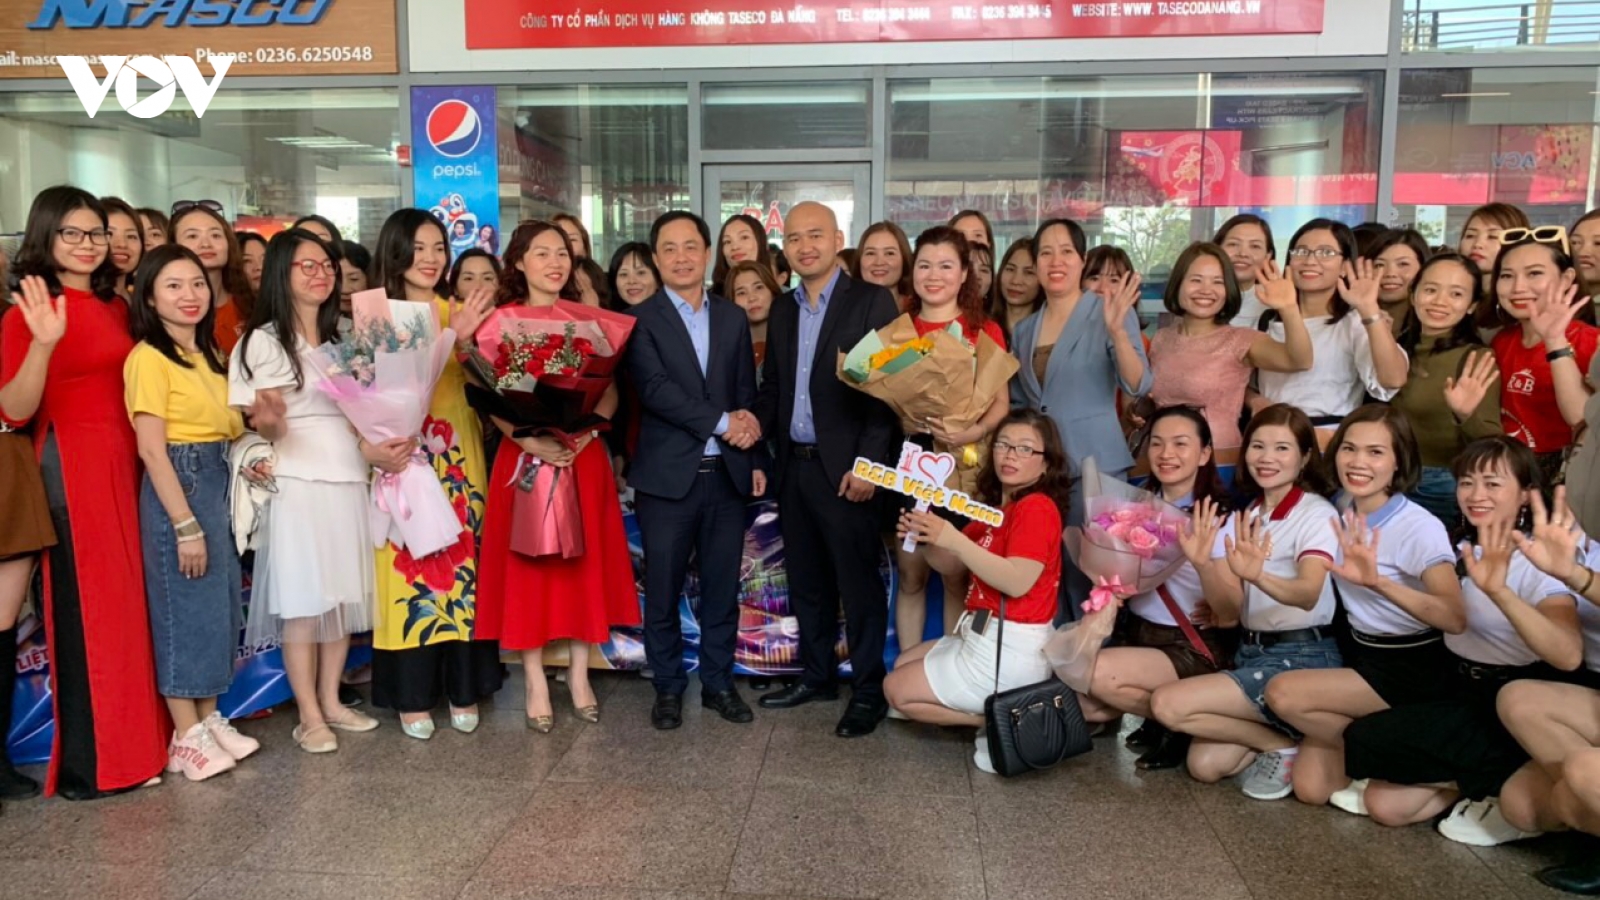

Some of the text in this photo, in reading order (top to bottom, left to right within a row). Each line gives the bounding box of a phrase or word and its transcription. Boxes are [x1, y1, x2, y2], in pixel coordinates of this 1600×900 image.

[520, 12, 547, 28] CÔNG
[551, 14, 564, 28] TY
[566, 8, 581, 28] CỔ
[615, 13, 638, 30] DỊCH
[641, 13, 654, 30] VỤ
[658, 9, 686, 26] HÀNG
[690, 8, 725, 26] KHÔNG
[727, 9, 766, 25] TASECO
[770, 7, 785, 24] ĐÀ
[1072, 2, 1122, 18] WEBSITE:
[256, 46, 373, 63] 0236.6250548
[433, 161, 477, 180] pepsi
[854, 459, 1002, 524] R&B Việt Nam
